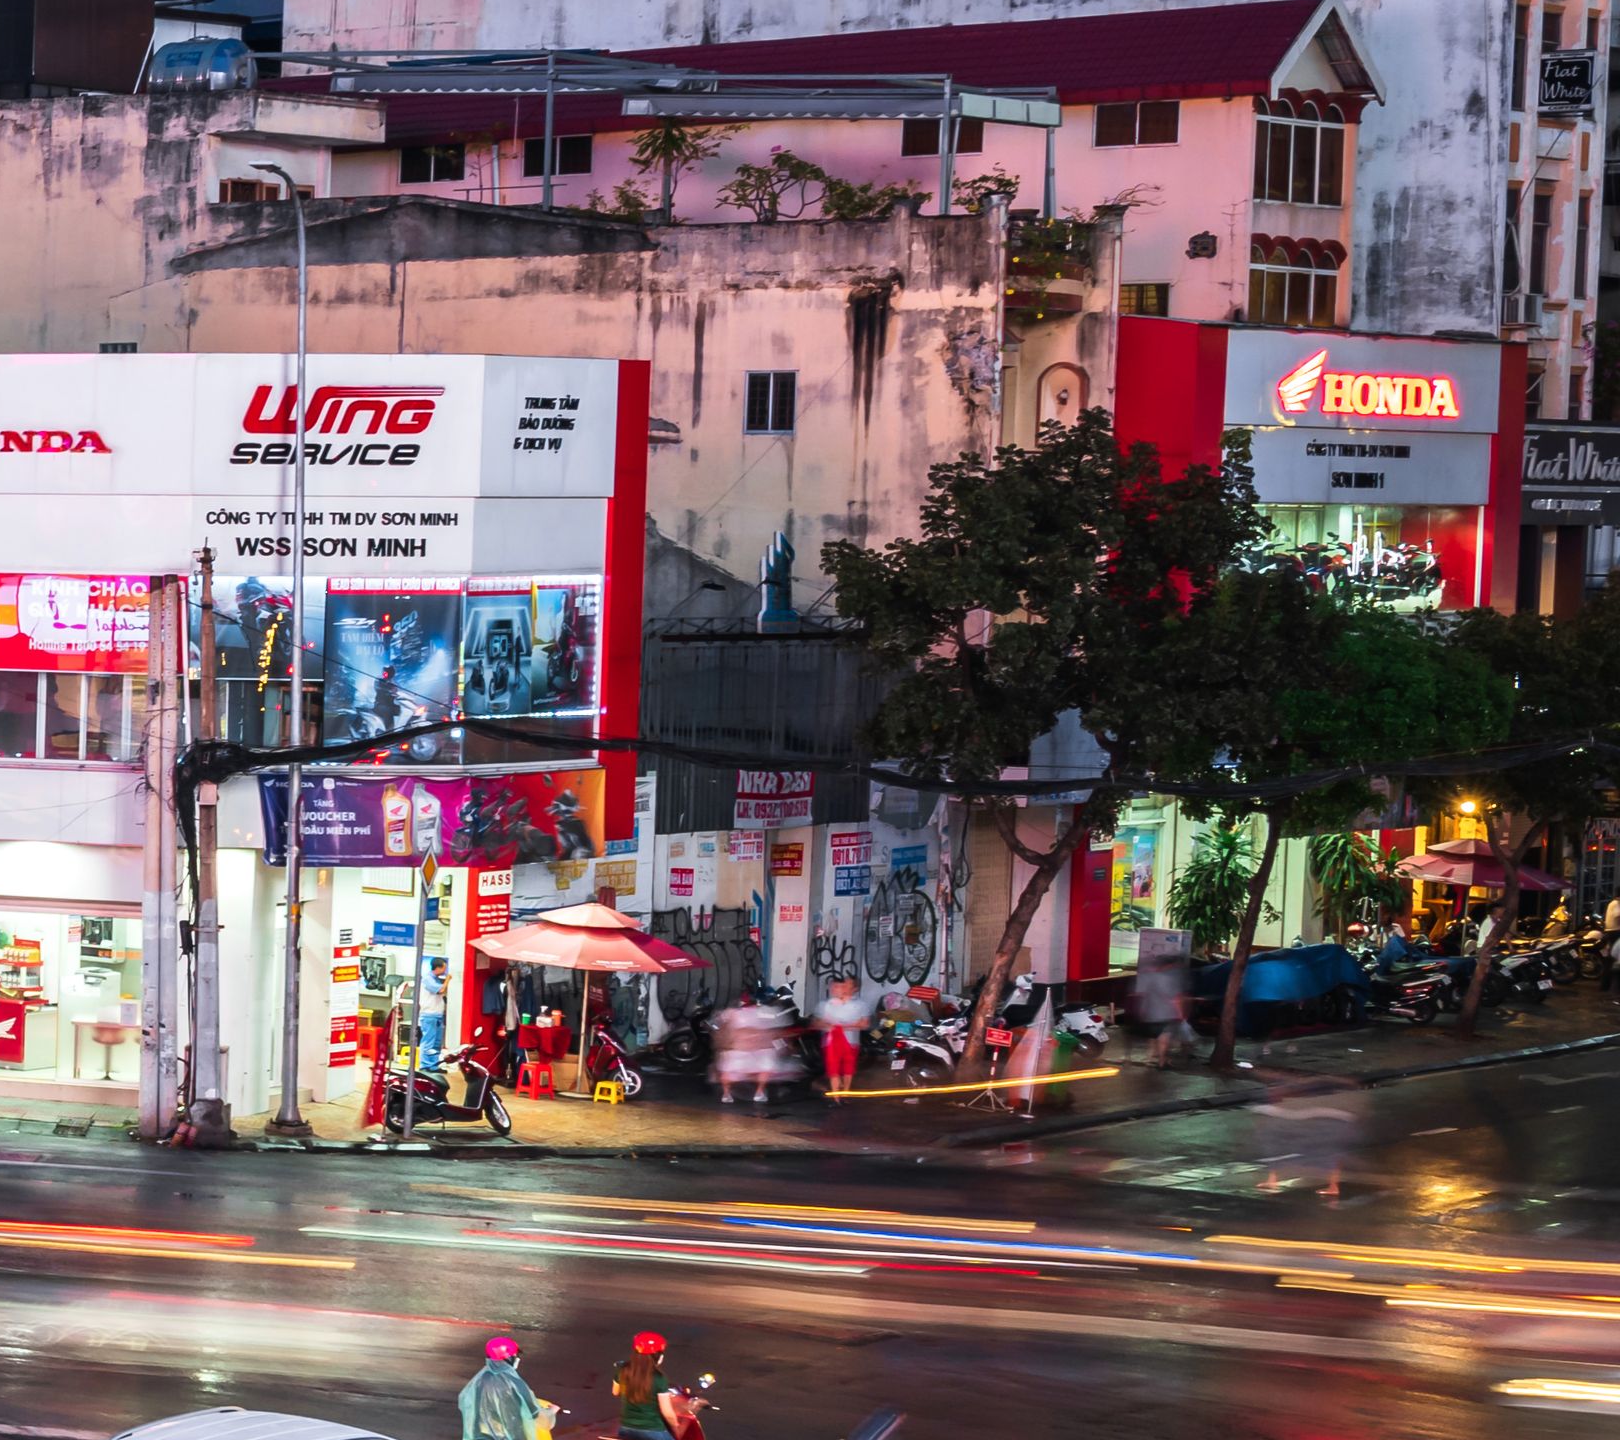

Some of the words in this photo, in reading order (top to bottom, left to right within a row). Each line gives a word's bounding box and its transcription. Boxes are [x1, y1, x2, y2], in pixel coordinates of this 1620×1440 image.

[1544, 59, 1581, 79] Flat
[1322, 373, 1460, 418] HONDA
[236, 537, 292, 556] WSS
[303, 536, 358, 557] SƠN
[367, 538, 427, 557] MINH
[481, 873, 512, 887] HASS
